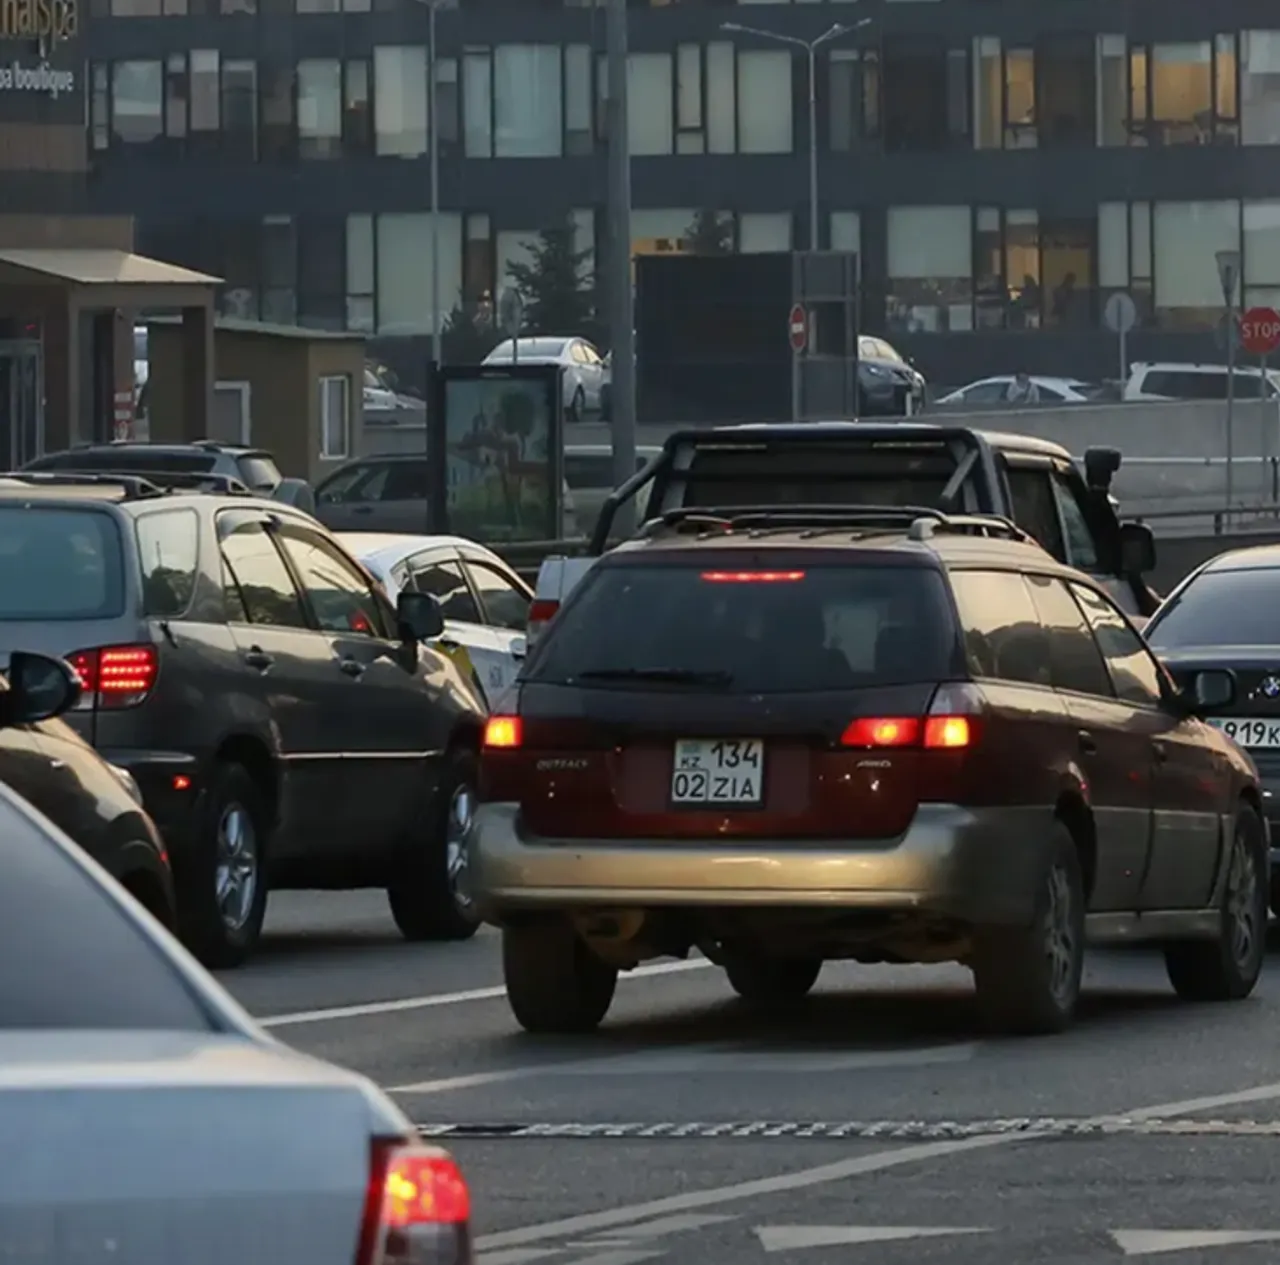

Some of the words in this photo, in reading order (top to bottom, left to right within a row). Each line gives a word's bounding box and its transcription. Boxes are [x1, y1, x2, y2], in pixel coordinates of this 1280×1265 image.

[1242, 322, 1280, 338] STOP
[681, 756, 701, 768] KZ
[711, 741, 758, 768] 134
[675, 773, 705, 798] 02
[713, 777, 754, 798] ZIA
